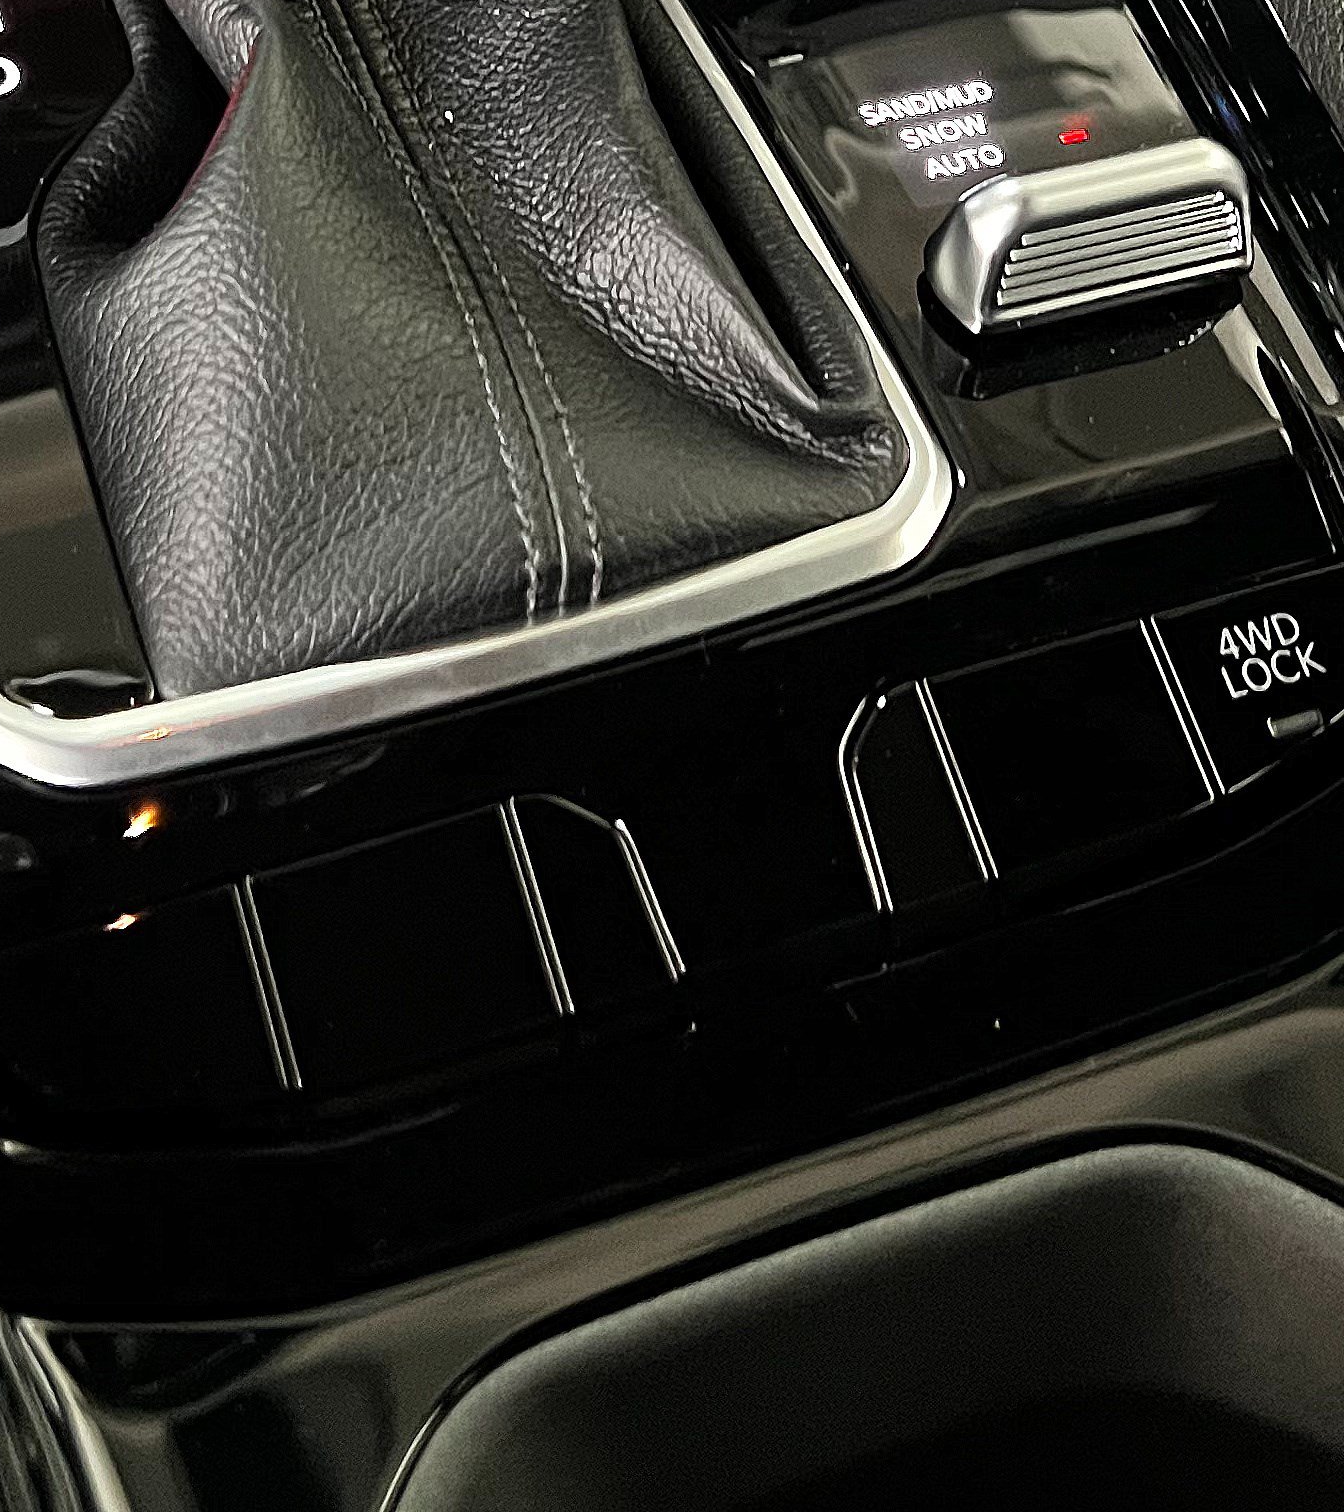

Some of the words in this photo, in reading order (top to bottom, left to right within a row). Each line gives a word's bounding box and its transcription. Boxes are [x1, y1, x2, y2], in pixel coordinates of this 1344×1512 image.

[858, 79, 994, 128] SAND/MUD
[897, 112, 989, 151] SNOW
[926, 143, 1006, 181] AUTO
[1219, 612, 1300, 660] 4WD
[1220, 641, 1327, 700] LOCK
